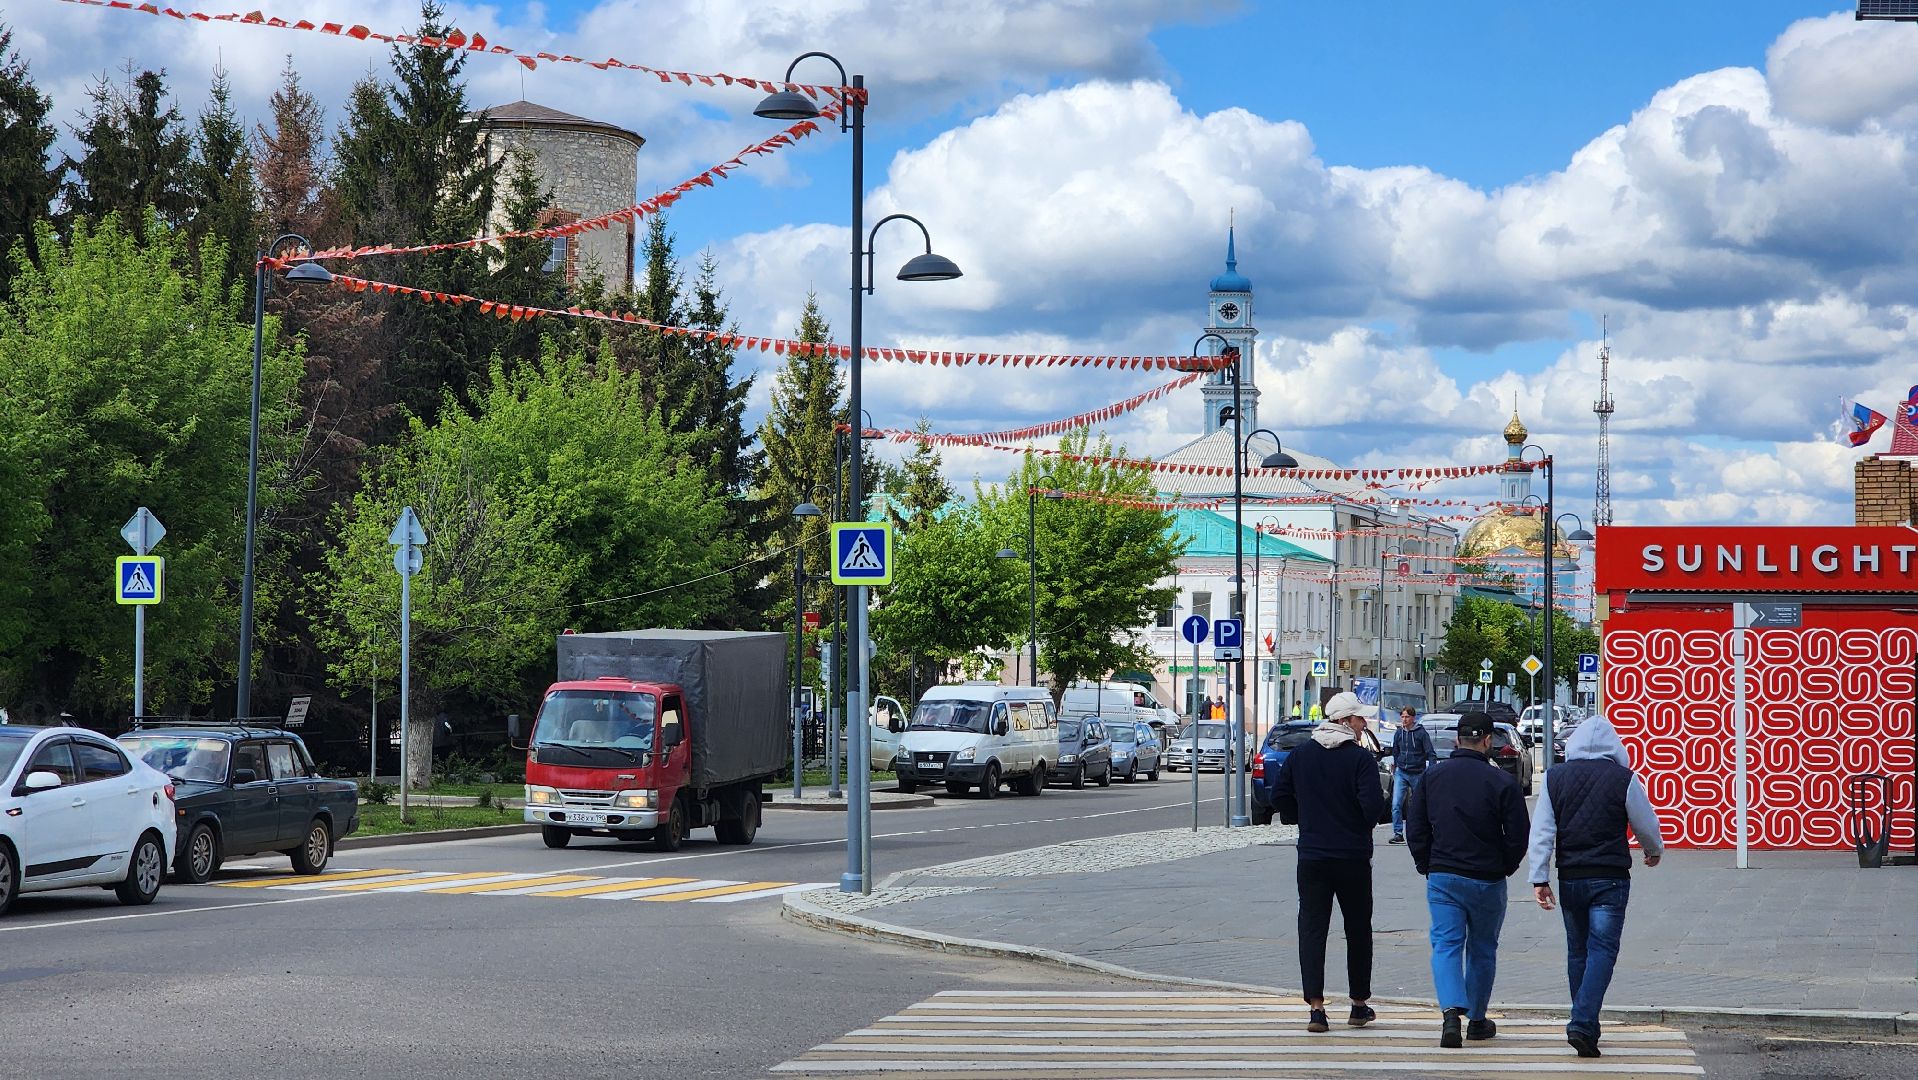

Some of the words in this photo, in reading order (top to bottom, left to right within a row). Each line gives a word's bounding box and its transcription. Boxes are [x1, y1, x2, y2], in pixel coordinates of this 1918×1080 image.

[1642, 544, 1916, 572] SUNLIGHT
[1220, 621, 1236, 645] P
[1583, 656, 1595, 671] P
